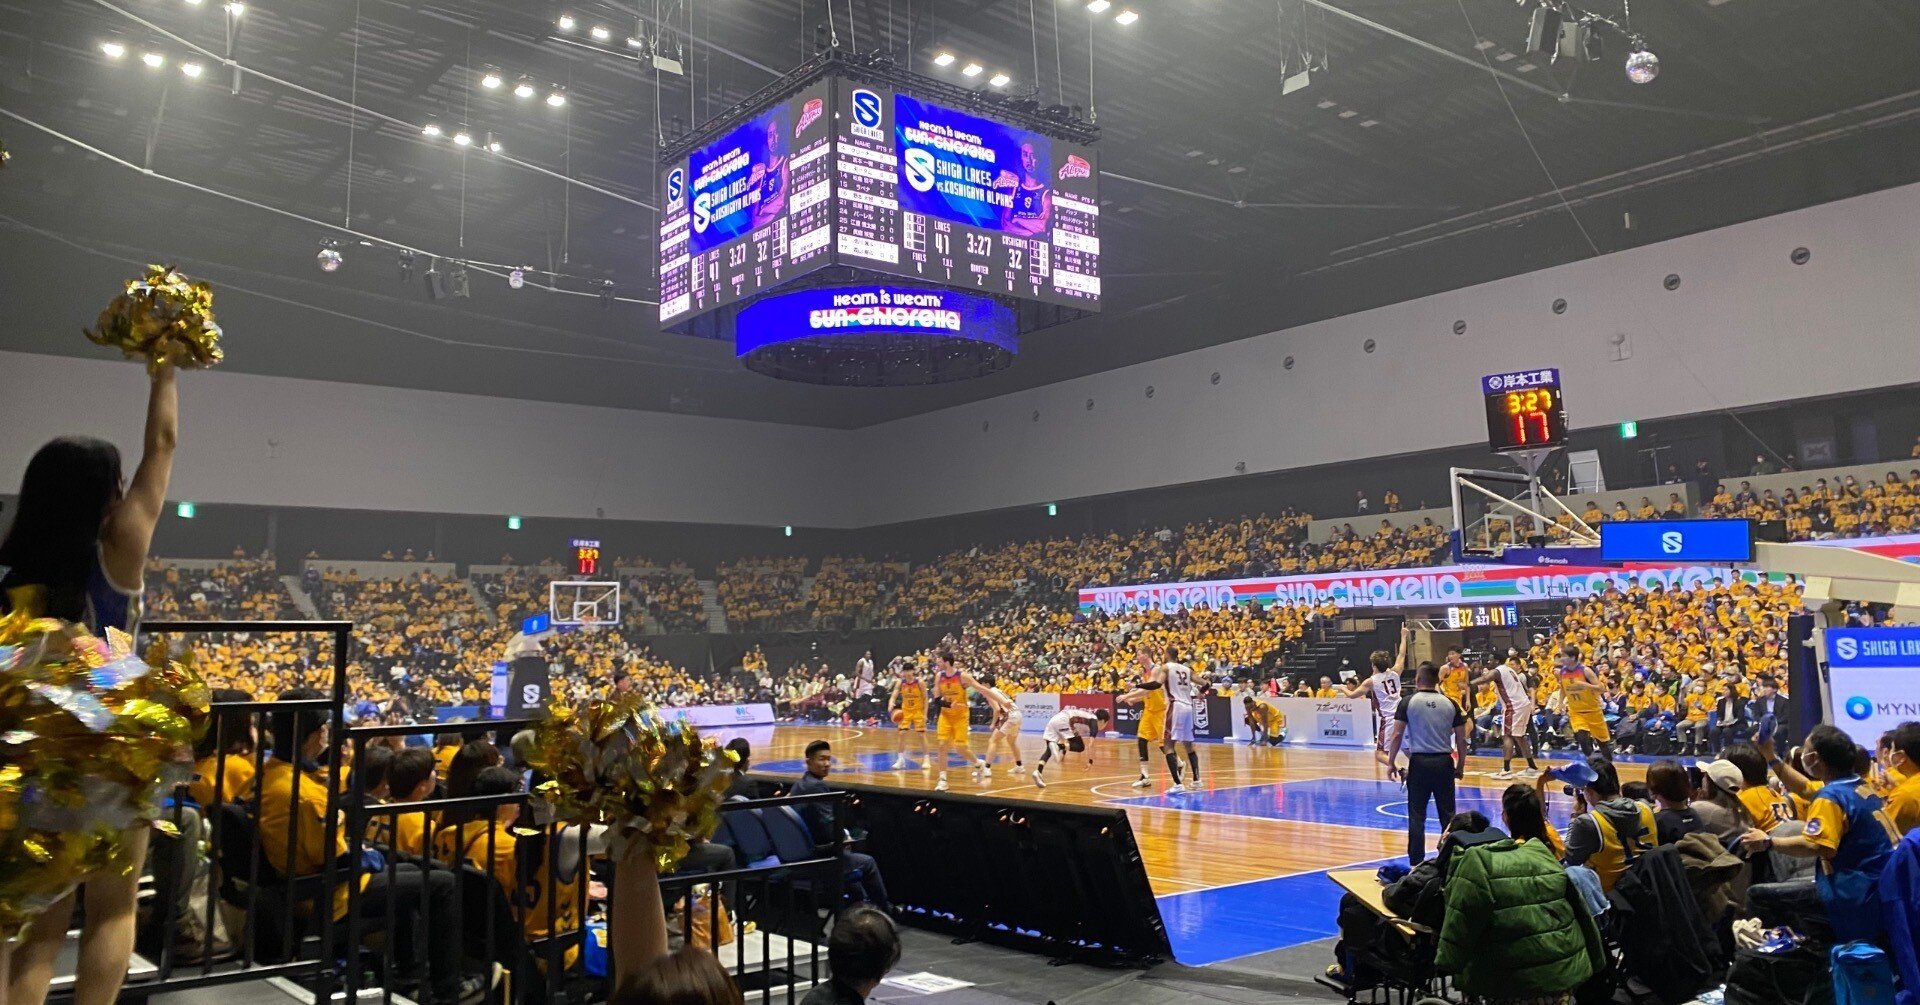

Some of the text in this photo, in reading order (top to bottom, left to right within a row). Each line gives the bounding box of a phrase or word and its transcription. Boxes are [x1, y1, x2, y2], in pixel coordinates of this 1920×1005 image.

[855, 139, 871, 148] NAME
[876, 145, 887, 153] PTS
[936, 159, 992, 188] SHIGA LAKES
[986, 190, 1015, 209] ALPHAS
[934, 220, 951, 233] LAKES
[729, 243, 746, 267] 3:27
[757, 240, 767, 262] 32
[935, 233, 950, 255] 41
[966, 232, 992, 257] 3:27
[1008, 248, 1022, 270] 32
[977, 274, 983, 286] 2
[1503, 370, 1554, 388] 岸本工業
[1506, 390, 1552, 415] 3:27
[1518, 411, 1550, 444] 17
[1459, 609, 1473, 627] 32
[1491, 607, 1505, 625] 41
[1862, 640, 1898, 656] SHIGA
[1381, 679, 1397, 695] 13
[1877, 703, 1920, 715] MYN
[1323, 729, 1347, 737] WINNER
